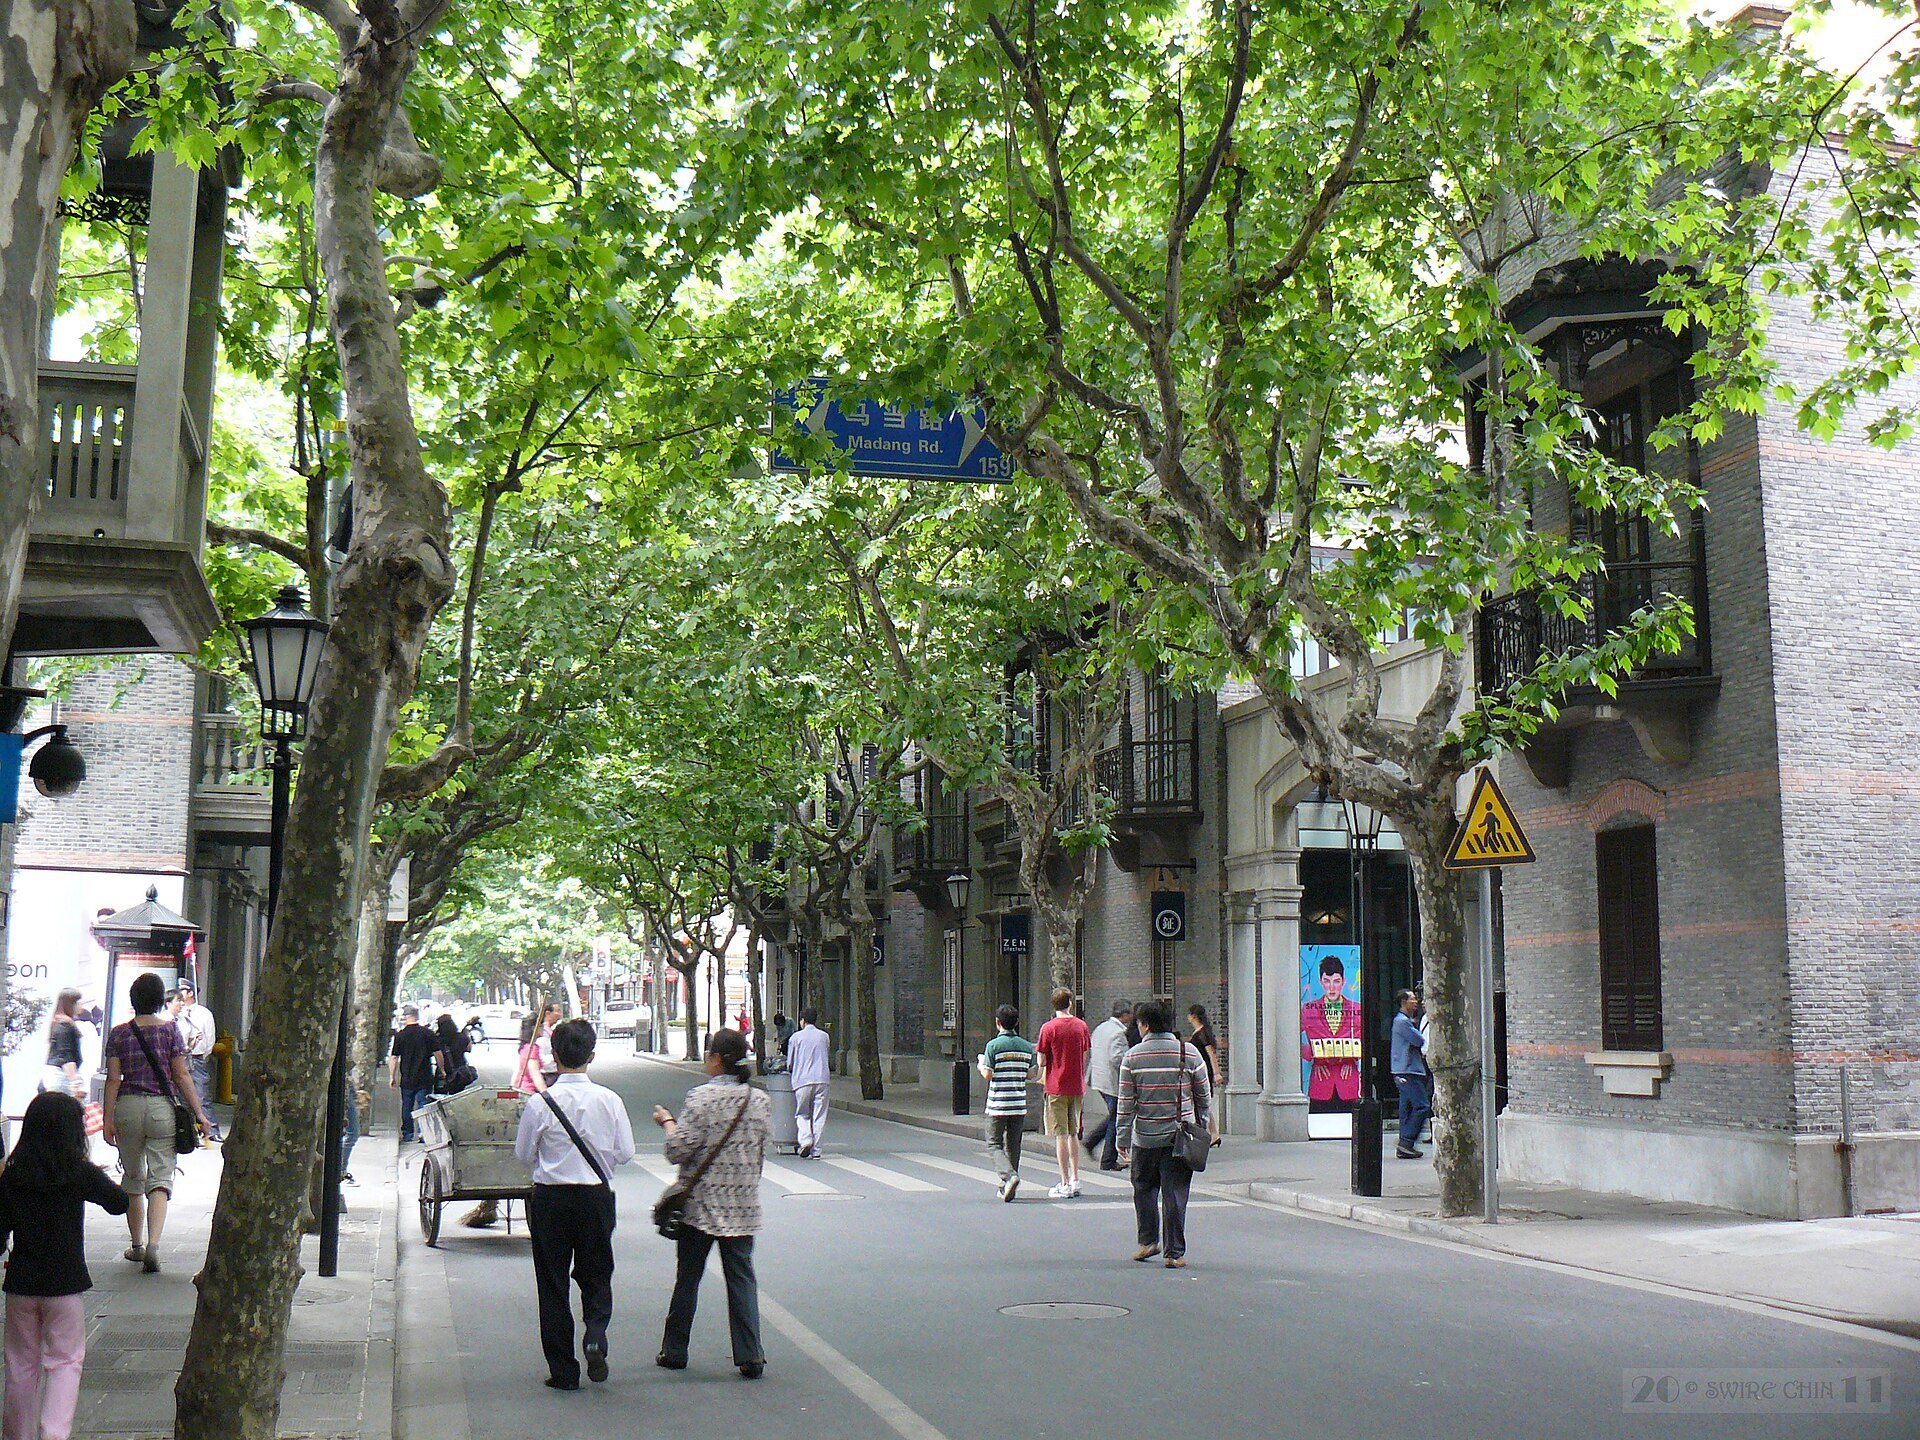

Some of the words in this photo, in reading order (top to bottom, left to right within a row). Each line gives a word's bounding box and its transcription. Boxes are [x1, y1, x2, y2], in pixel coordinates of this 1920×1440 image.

[848, 435, 911, 455] Madang
[918, 440, 944, 454] Rd.
[978, 457, 1011, 477] 159
[1003, 938, 1026, 947] ZEN
